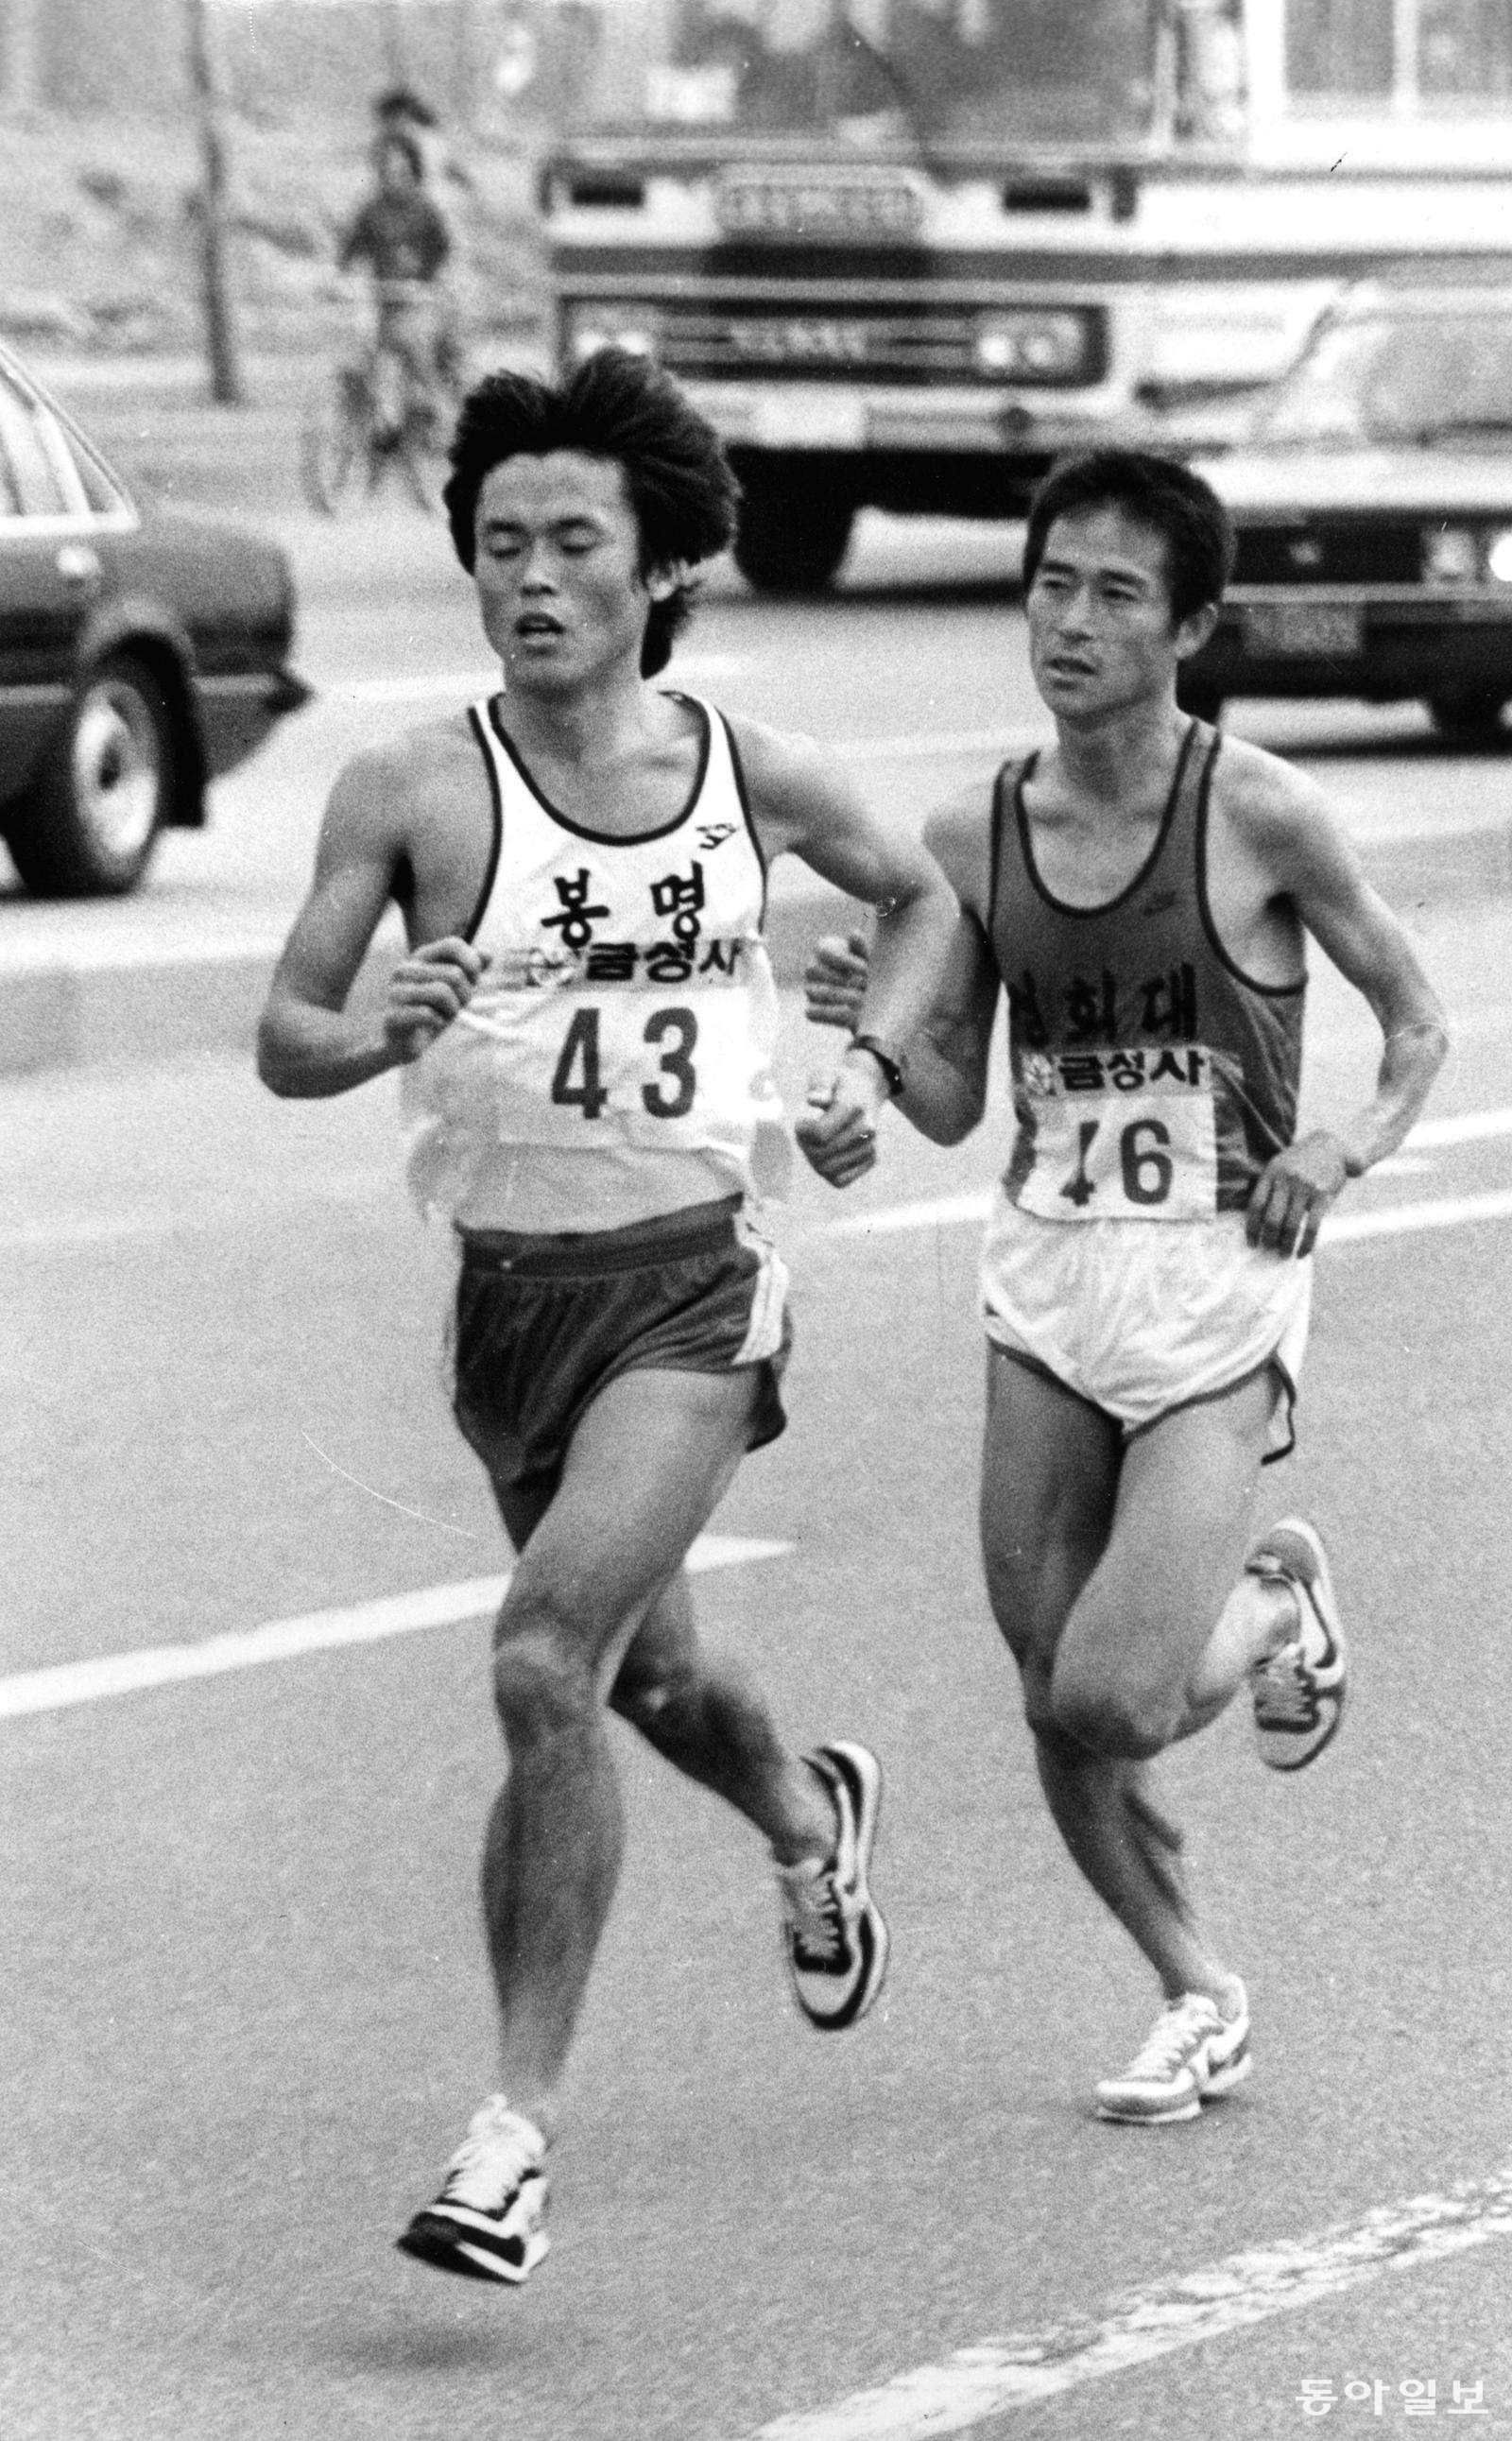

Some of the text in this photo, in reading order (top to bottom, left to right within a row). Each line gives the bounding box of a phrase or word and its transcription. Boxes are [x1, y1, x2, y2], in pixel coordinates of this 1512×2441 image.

[585, 937, 744, 984] 금성사
[551, 1006, 698, 1120] 43
[1058, 1050, 1204, 1091] 금성사
